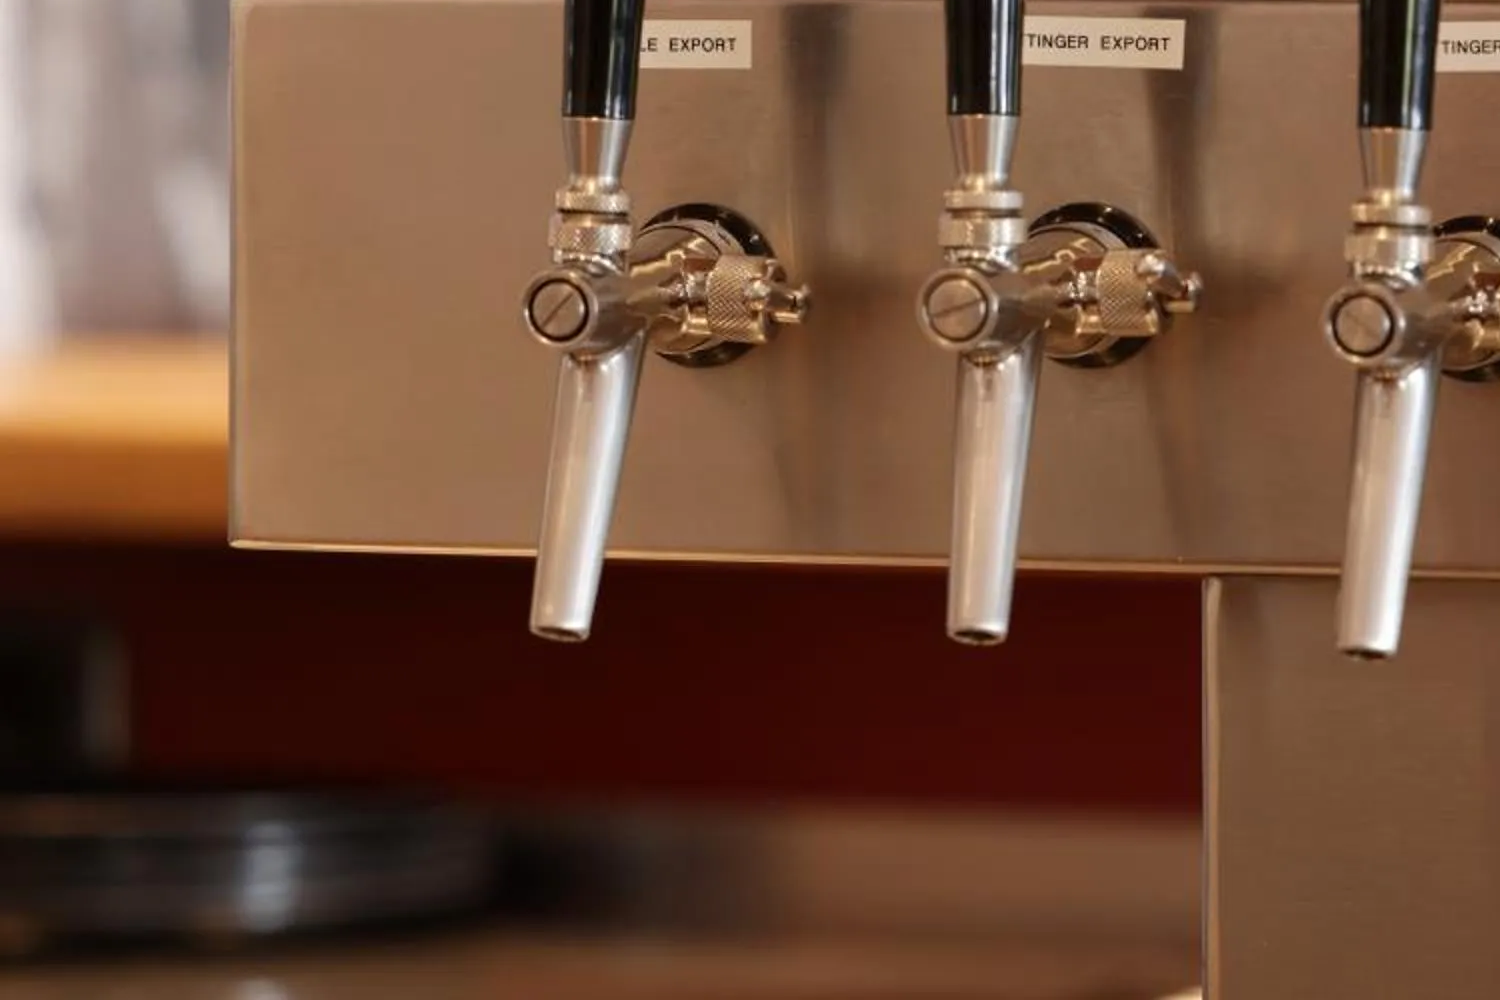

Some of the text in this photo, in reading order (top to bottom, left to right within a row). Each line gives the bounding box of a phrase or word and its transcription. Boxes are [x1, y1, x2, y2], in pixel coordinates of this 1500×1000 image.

[669, 37, 737, 52] EXPORT
[1024, 33, 1171, 52] TINGER EXPORT
